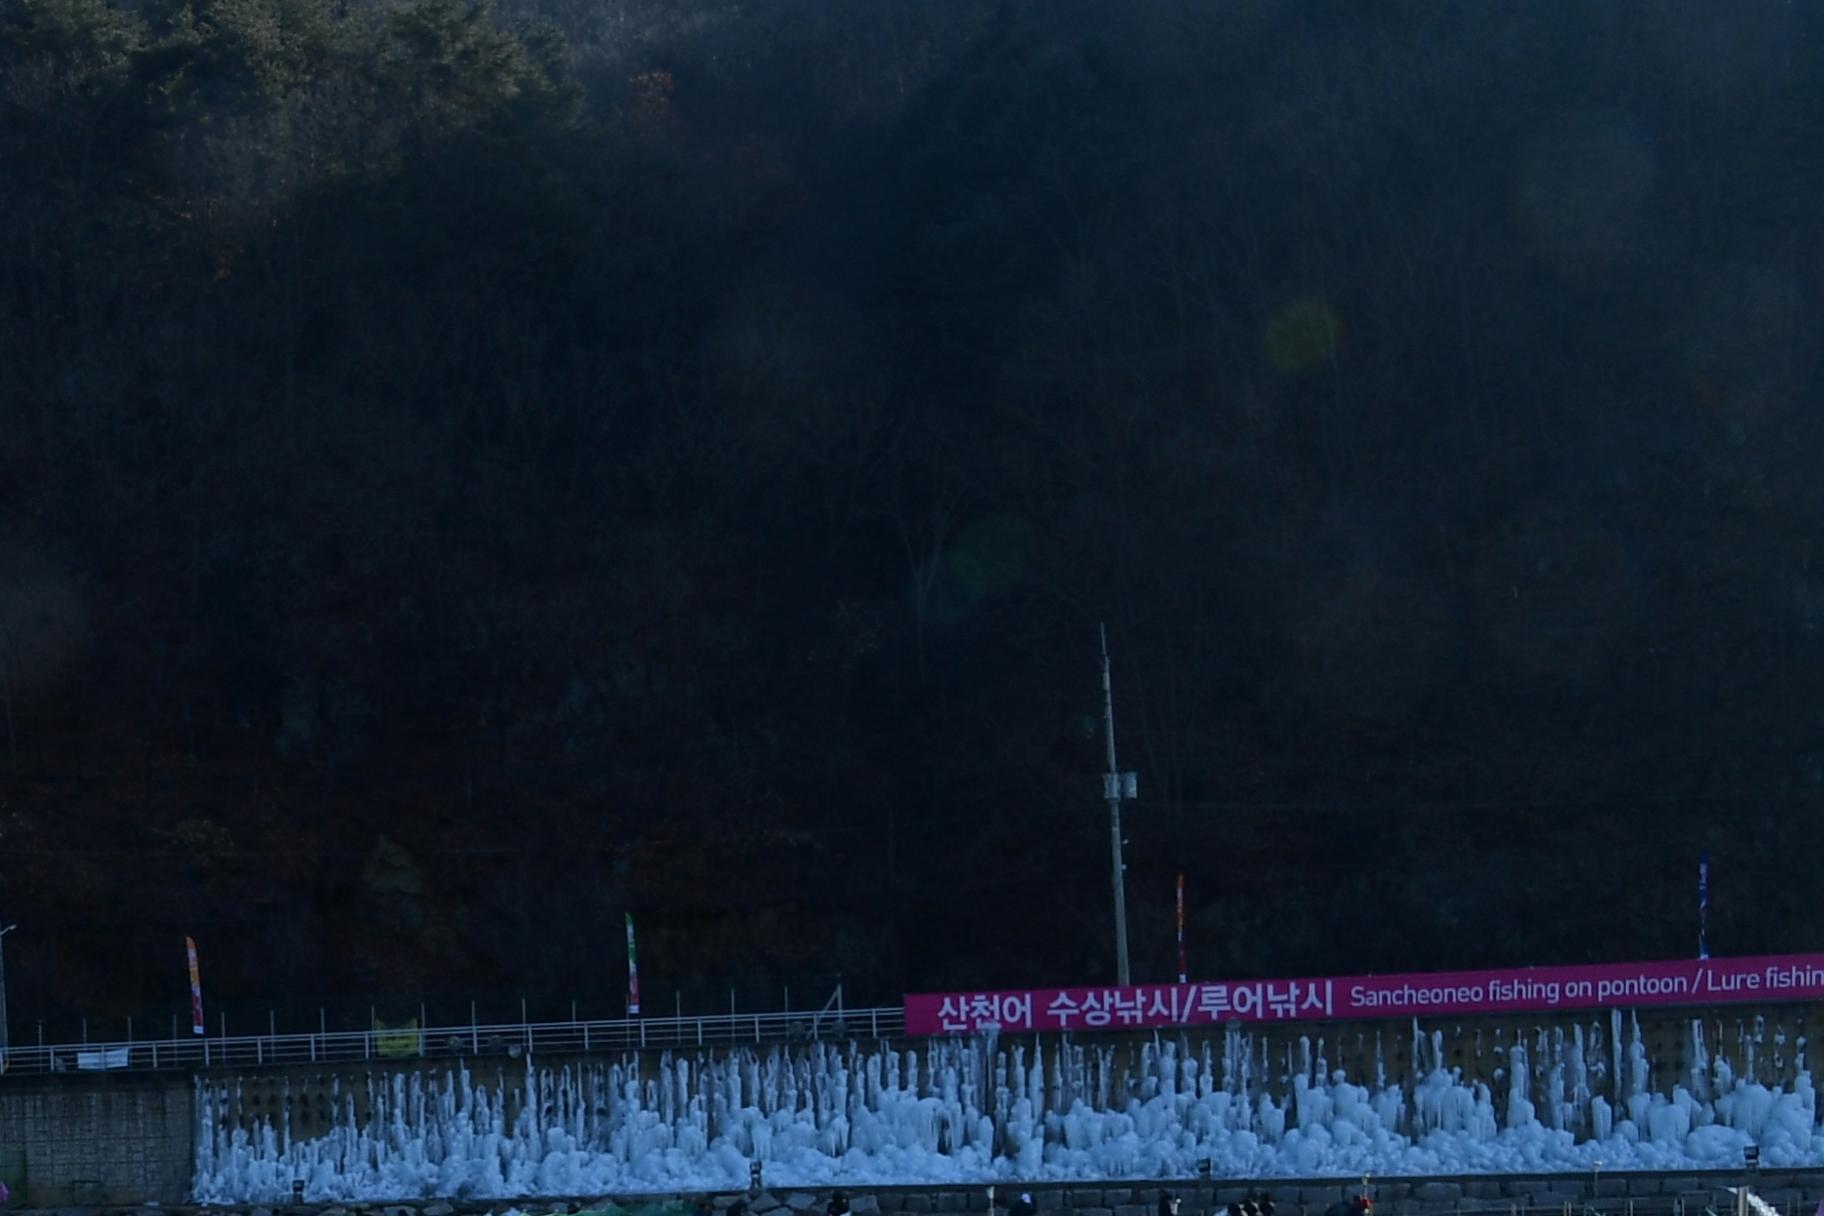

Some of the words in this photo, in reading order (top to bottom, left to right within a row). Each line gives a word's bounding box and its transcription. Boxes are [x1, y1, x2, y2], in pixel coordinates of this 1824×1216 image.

[936, 993, 1033, 1031] 산천어
[1046, 981, 1334, 1026] 수상낚시/루어낚시
[1350, 984, 1484, 1007] Sancheoneo
[1488, 979, 1560, 1003] fishing
[1564, 980, 1592, 998] on
[1597, 974, 1688, 1002] pontoon
[1707, 970, 1761, 992] Lure
